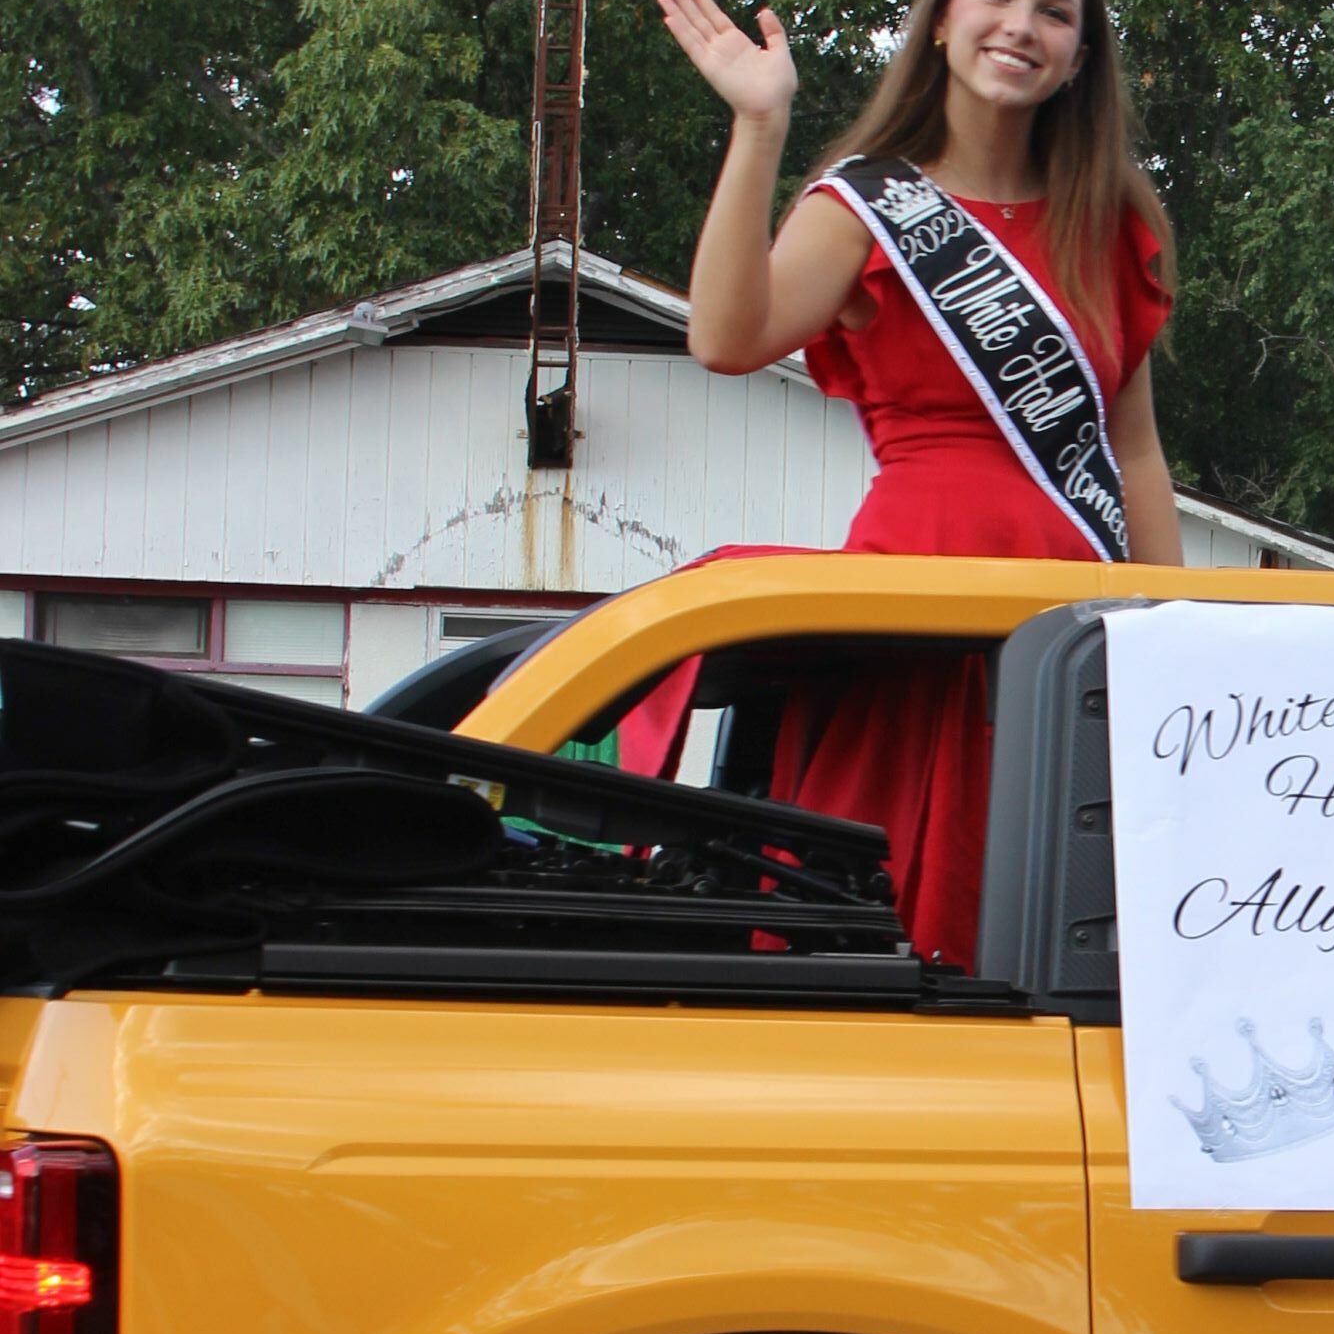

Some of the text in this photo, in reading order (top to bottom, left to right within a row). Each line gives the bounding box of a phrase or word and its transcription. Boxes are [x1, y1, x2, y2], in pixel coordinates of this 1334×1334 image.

[899, 208, 975, 265] 2022
[930, 243, 1035, 352] White
[1000, 333, 1087, 433] Hall
